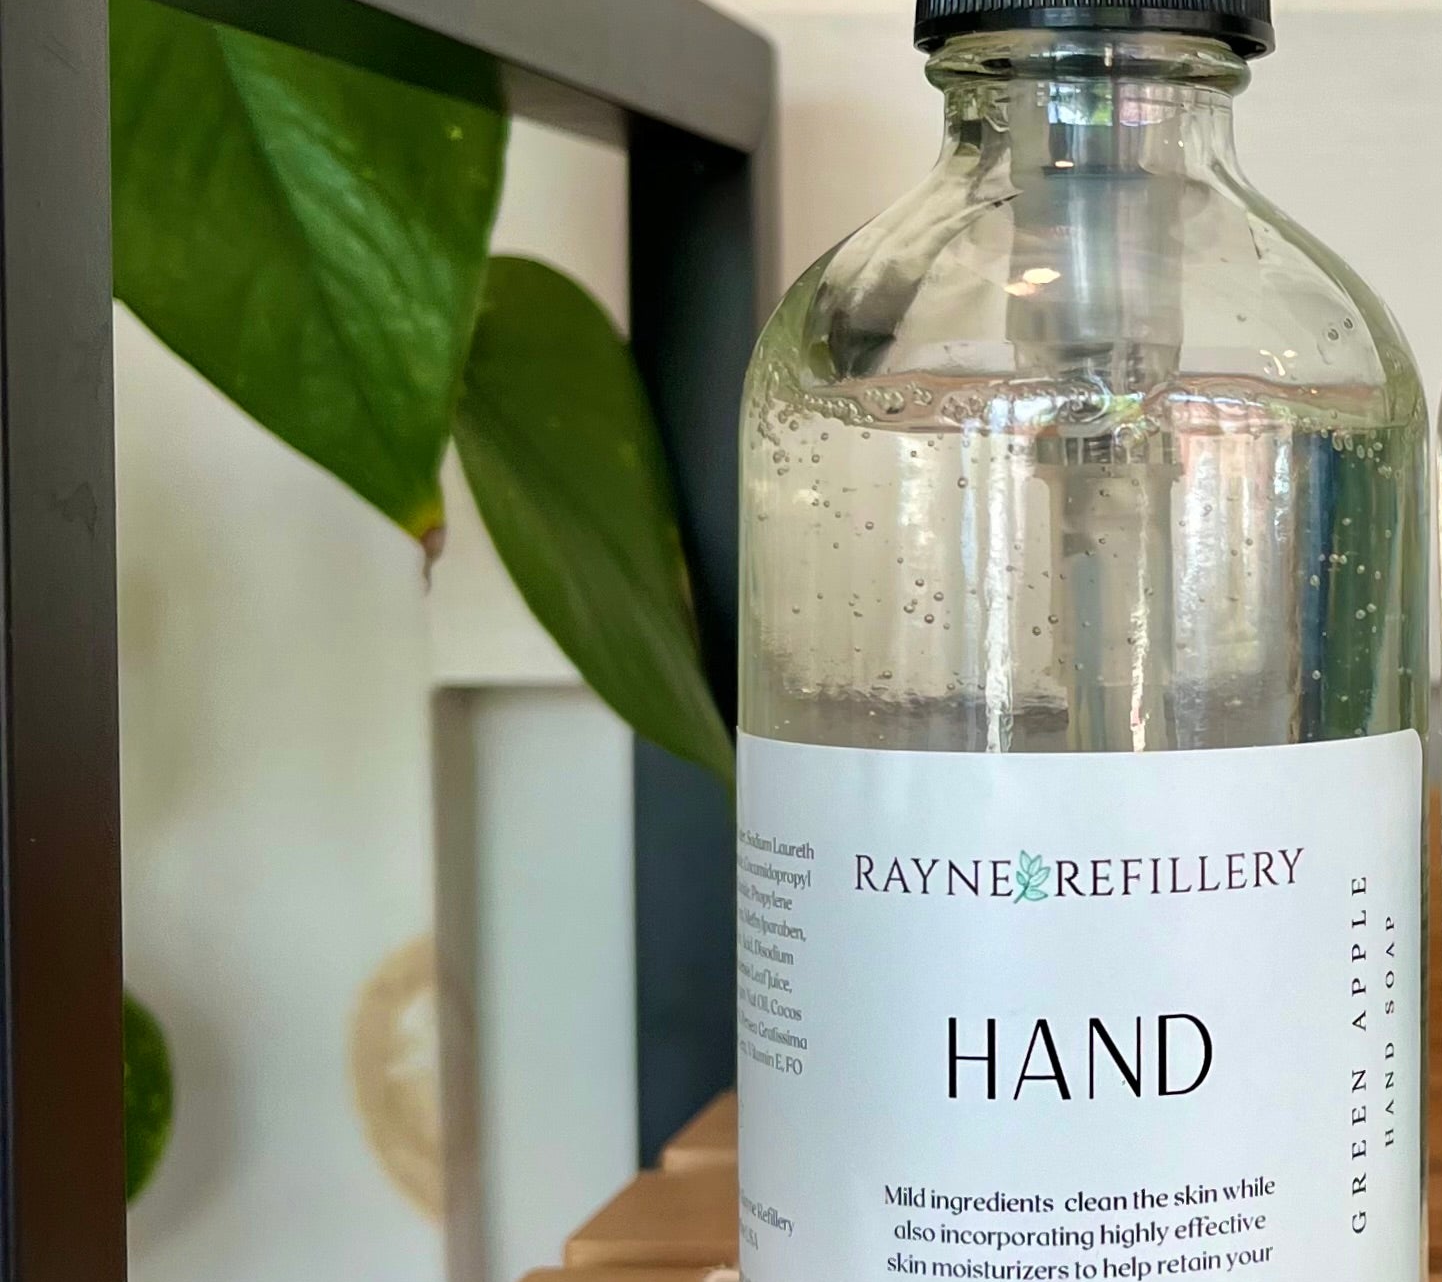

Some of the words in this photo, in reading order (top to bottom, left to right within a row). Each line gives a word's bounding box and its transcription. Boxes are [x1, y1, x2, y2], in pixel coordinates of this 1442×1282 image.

[773, 837, 815, 860] Laureth
[853, 853, 1014, 898] RAYNE
[1053, 846, 1305, 898] REFILLERY
[1351, 875, 1368, 1032] APPLE
[1384, 915, 1396, 1016] SOAP
[770, 998, 803, 1021] Cocos
[785, 1056, 804, 1076] FO
[947, 1012, 1214, 1101] HAND
[1384, 1040, 1396, 1148] HAND
[1351, 1068, 1368, 1235] GREEN
[884, 1184, 926, 1209] Mild
[931, 1189, 1055, 1216] ingredients
[1064, 1190, 1128, 1213] clean
[1133, 1188, 1169, 1210] the
[1173, 1184, 1218, 1207] skin
[1222, 1175, 1276, 1201] while
[893, 1219, 937, 1243] also
[940, 1223, 1095, 1251] incorporating
[1100, 1220, 1170, 1249] highly
[1174, 1213, 1267, 1240] effective
[887, 1252, 927, 1276] skin
[932, 1258, 1070, 1280] moisturizers
[1074, 1260, 1098, 1280] to
[1103, 1255, 1152, 1282] help
[1157, 1250, 1222, 1275] retain
[1226, 1245, 1274, 1273] your
